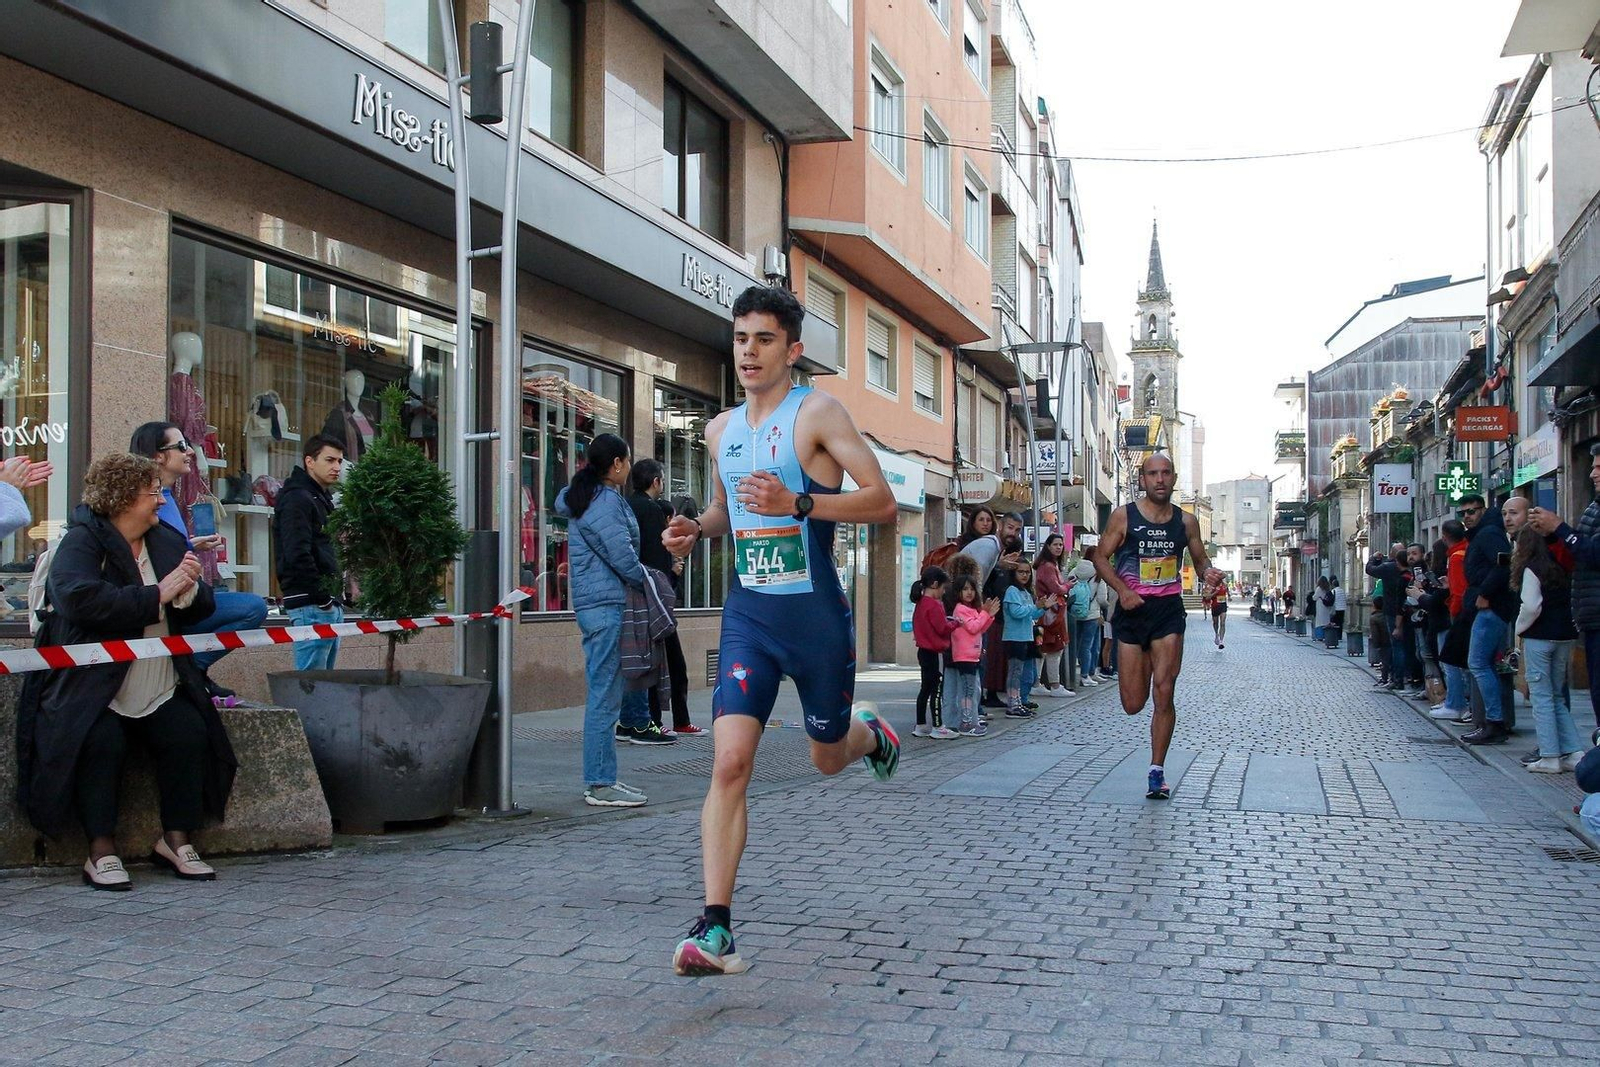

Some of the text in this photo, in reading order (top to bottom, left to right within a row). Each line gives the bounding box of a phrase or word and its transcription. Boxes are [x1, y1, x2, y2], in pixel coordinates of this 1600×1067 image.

[681, 253, 734, 309] Miss-tic
[1378, 482, 1409, 496] Tere
[1139, 540, 1145, 548] O
[745, 547, 785, 574] 544
[1155, 566, 1161, 579] 7
